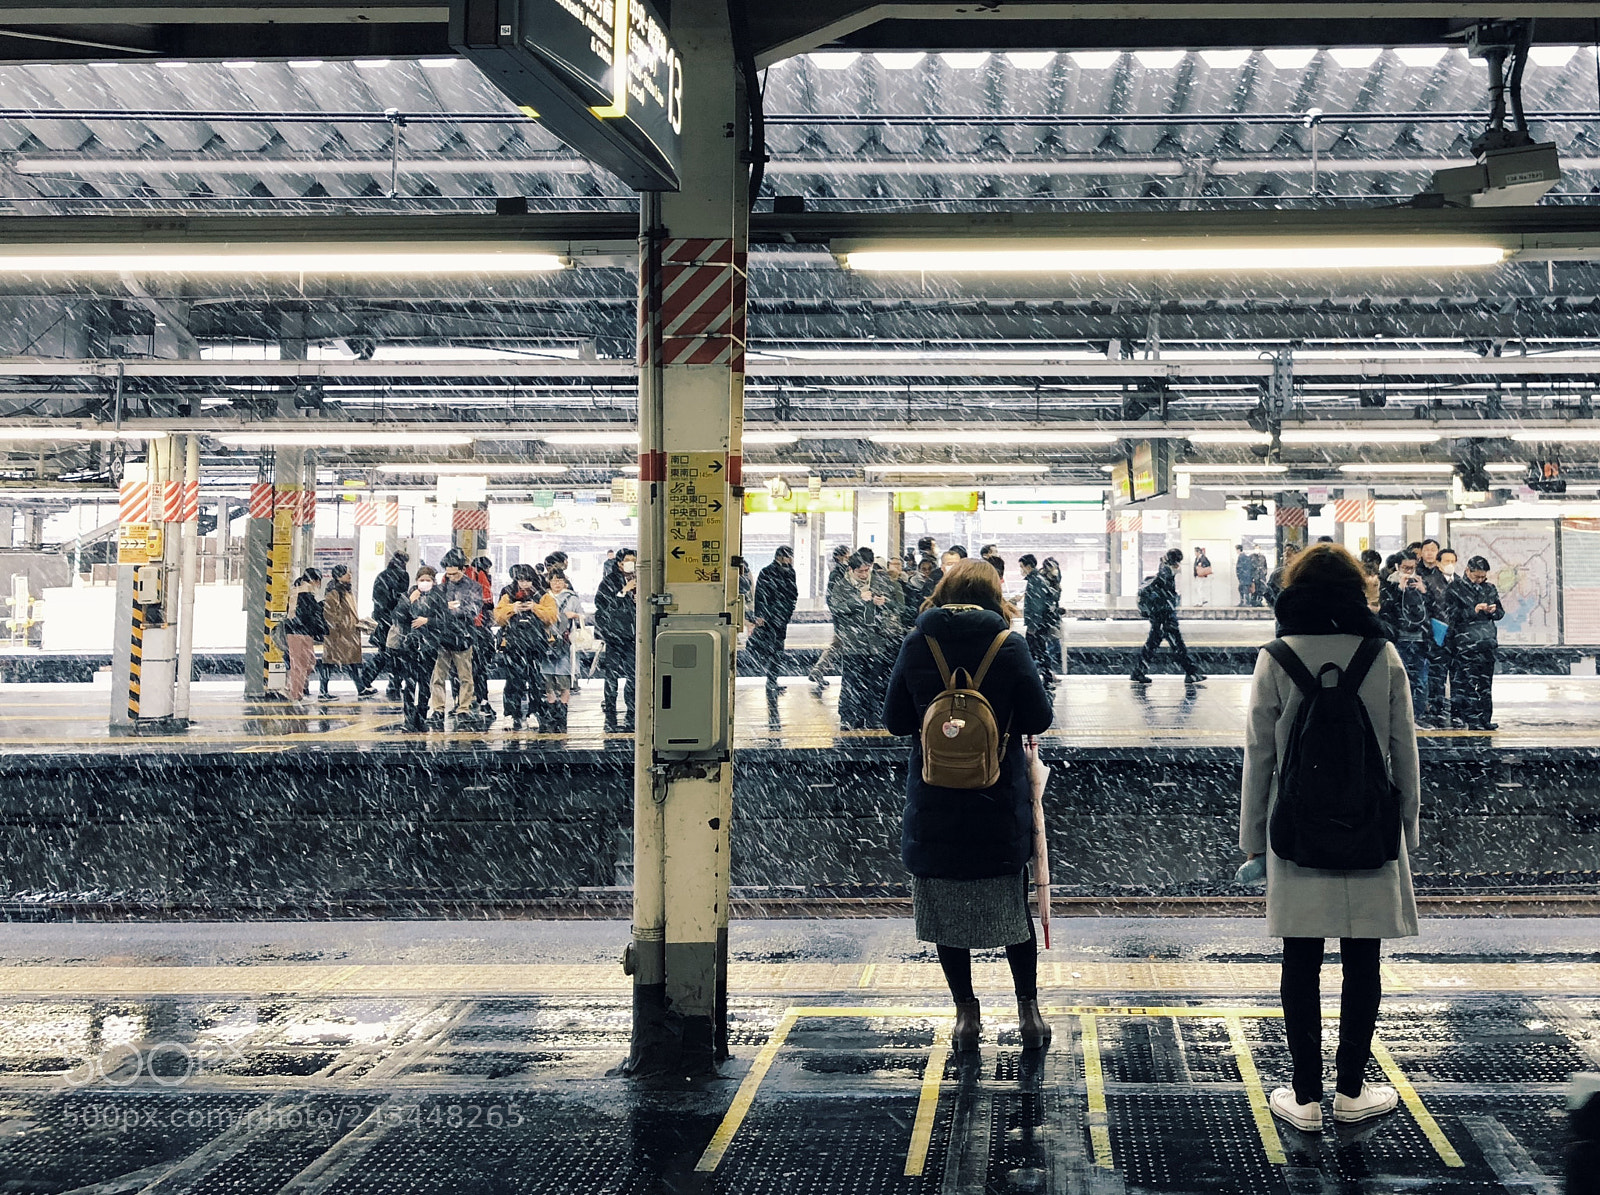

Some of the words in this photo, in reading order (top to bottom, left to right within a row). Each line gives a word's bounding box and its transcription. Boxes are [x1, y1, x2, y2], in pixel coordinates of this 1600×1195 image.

[667, 48, 682, 135] 13
[671, 456, 689, 464] 南口
[671, 469, 698, 477] 東南口
[670, 495, 707, 504] 中央東口
[670, 508, 707, 517] 中央西口
[702, 541, 720, 549] 東口
[702, 554, 720, 562] 西口
